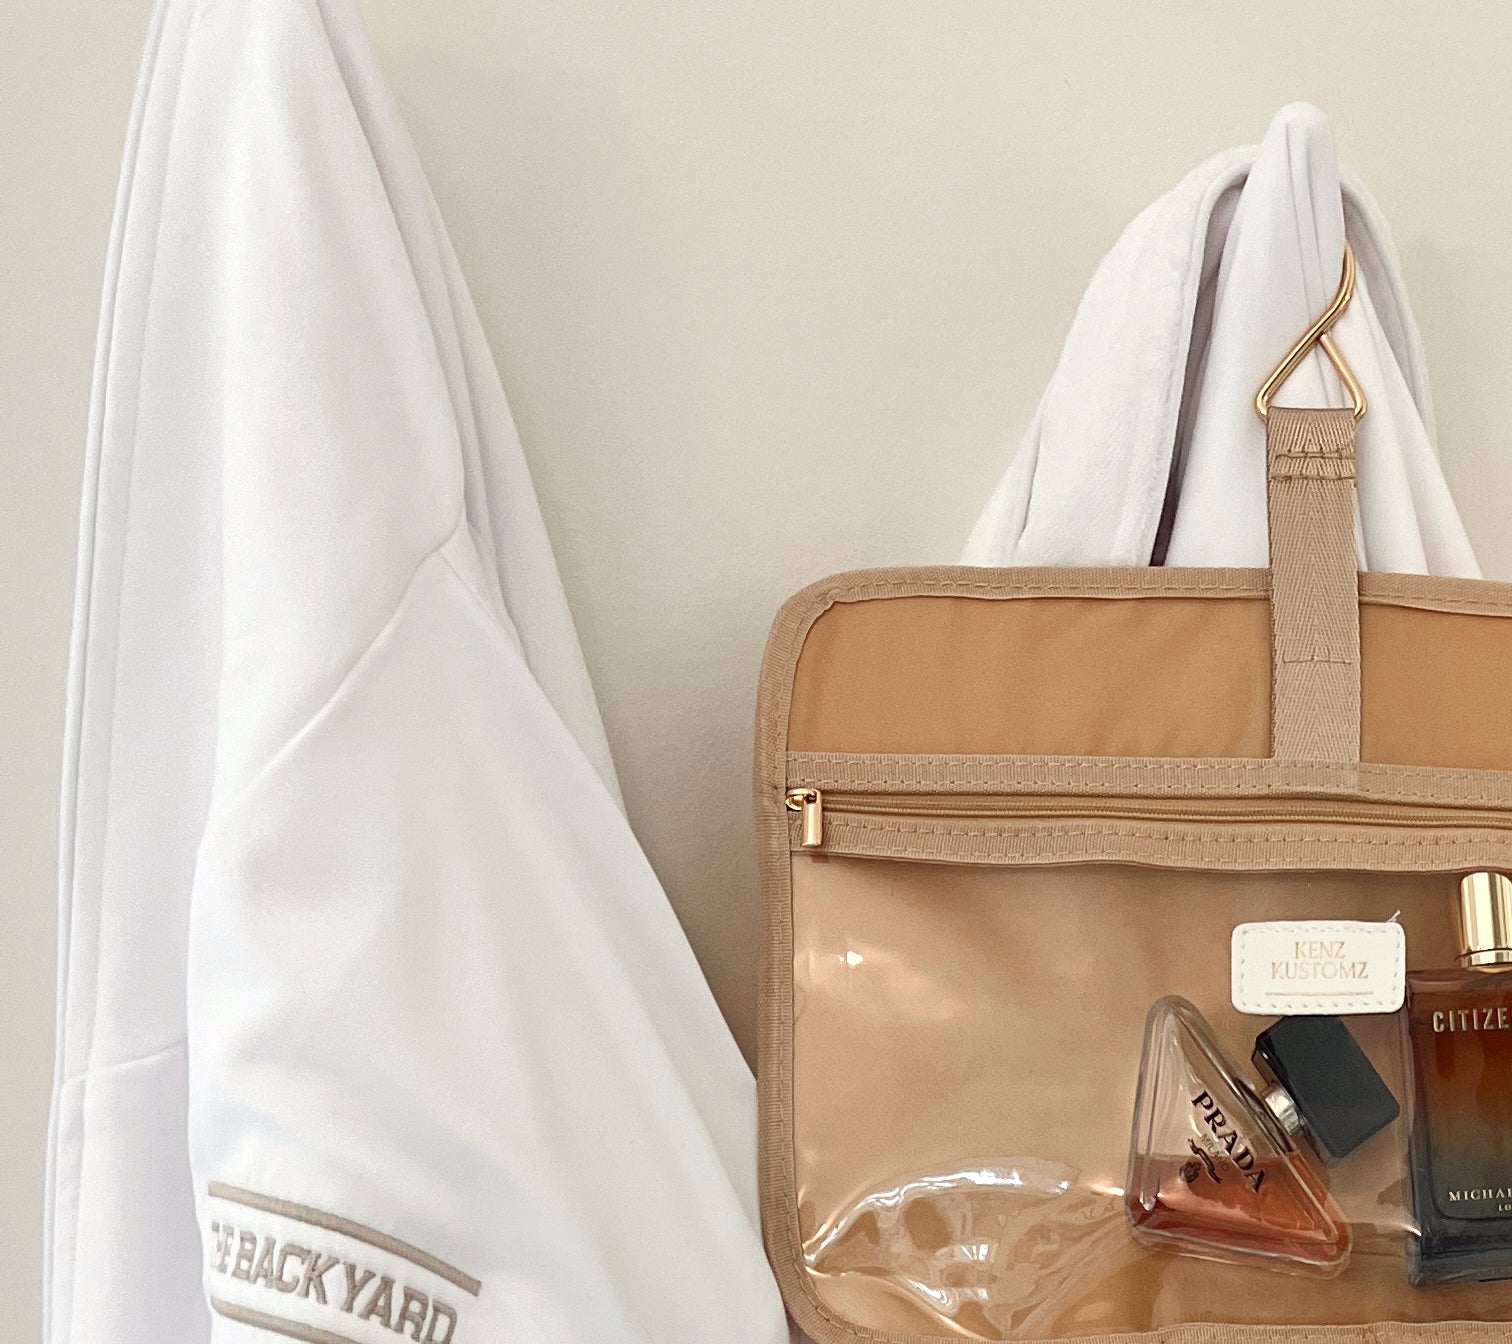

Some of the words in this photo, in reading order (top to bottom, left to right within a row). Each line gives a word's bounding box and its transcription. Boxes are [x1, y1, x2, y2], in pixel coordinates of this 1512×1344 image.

[1295, 941, 1345, 959] KENZ
[1272, 961, 1368, 979] KUSTOMZ
[1191, 1090, 1265, 1193] PRADA
